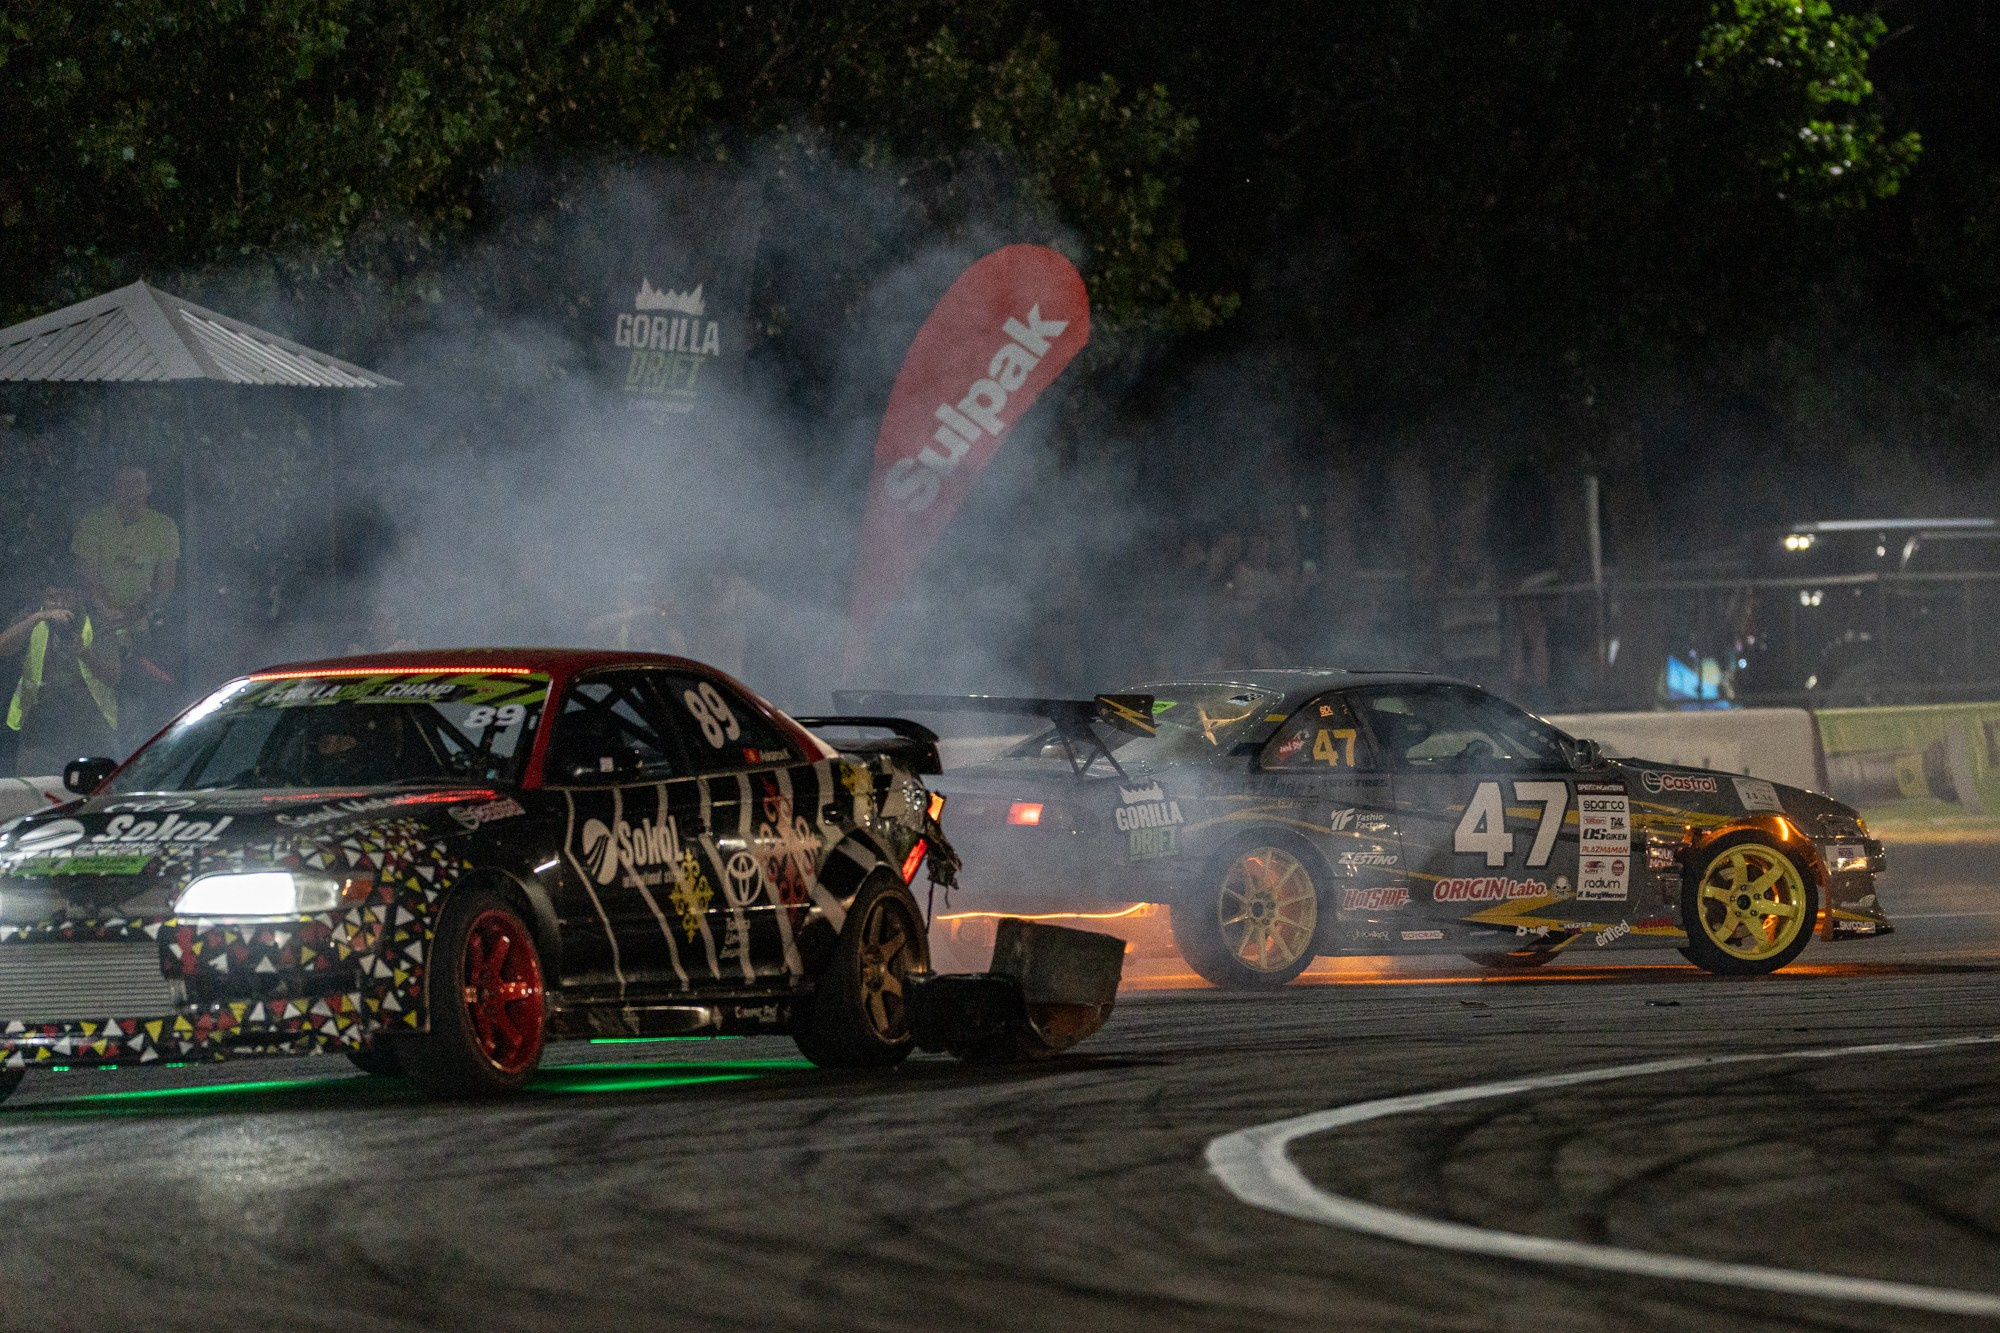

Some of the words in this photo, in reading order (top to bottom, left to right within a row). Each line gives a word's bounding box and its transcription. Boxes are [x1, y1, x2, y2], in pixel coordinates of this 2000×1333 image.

[614, 313, 719, 356] GORILLA
[883, 304, 1069, 512] Sulpak
[384, 683, 456, 698] CHAMP
[464, 703, 526, 729] 89
[683, 681, 740, 749] 89
[1313, 728, 1357, 767] 47
[1662, 775, 1717, 792] Castrol
[1115, 801, 1184, 831] GORILLA
[1356, 812, 1384, 821] Yashio
[1583, 800, 1625, 812] sparco
[92, 814, 233, 841] Sokol
[1454, 782, 1568, 866] 47
[1606, 833, 1628, 841] GIKEN
[1130, 825, 1179, 856] DRIFT
[1338, 852, 1398, 865] ZESTINO
[1433, 877, 1507, 901] ORIGIN
[1508, 879, 1547, 898] Labo.
[1584, 876, 1620, 888] radium
[1585, 891, 1626, 899] BorgWarner
[1594, 919, 1630, 947] drifted
